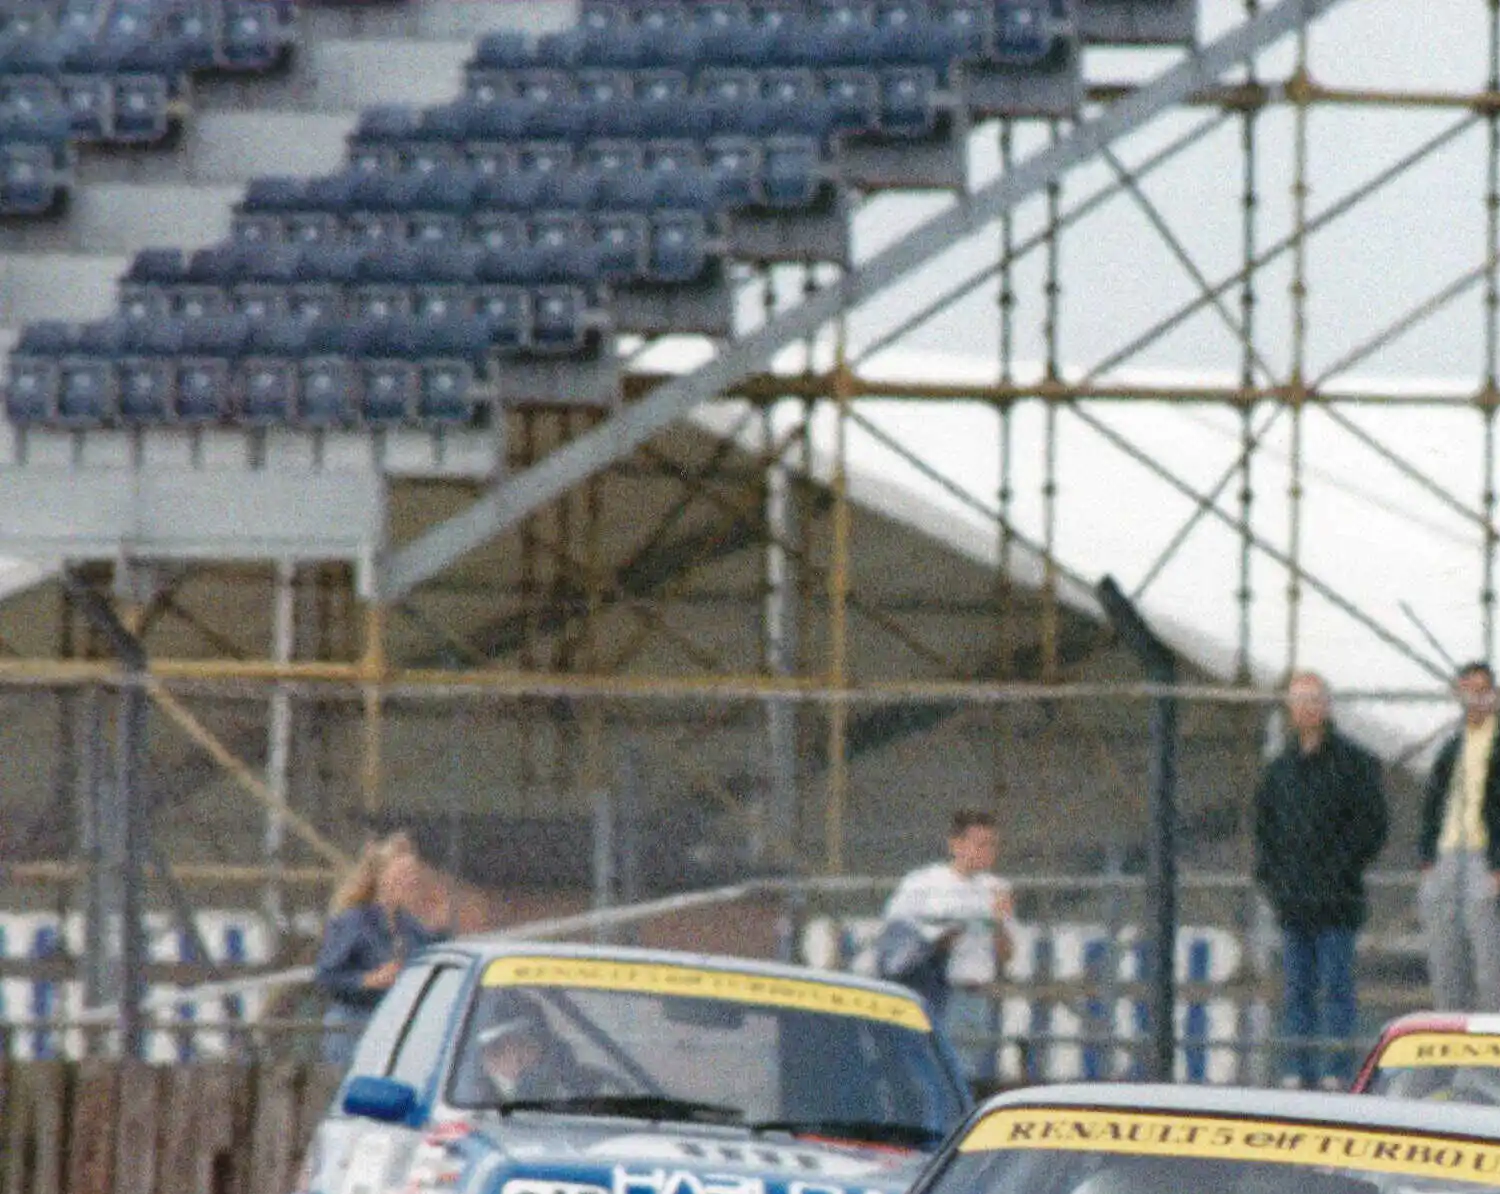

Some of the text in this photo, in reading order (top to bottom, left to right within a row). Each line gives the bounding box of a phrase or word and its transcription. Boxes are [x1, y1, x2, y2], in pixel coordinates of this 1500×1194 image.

[1007, 1120, 1209, 1145] RENAULT
[1210, 1126, 1236, 1147] 5
[1242, 1130, 1306, 1152] elf
[1314, 1135, 1464, 1169] TURBO
